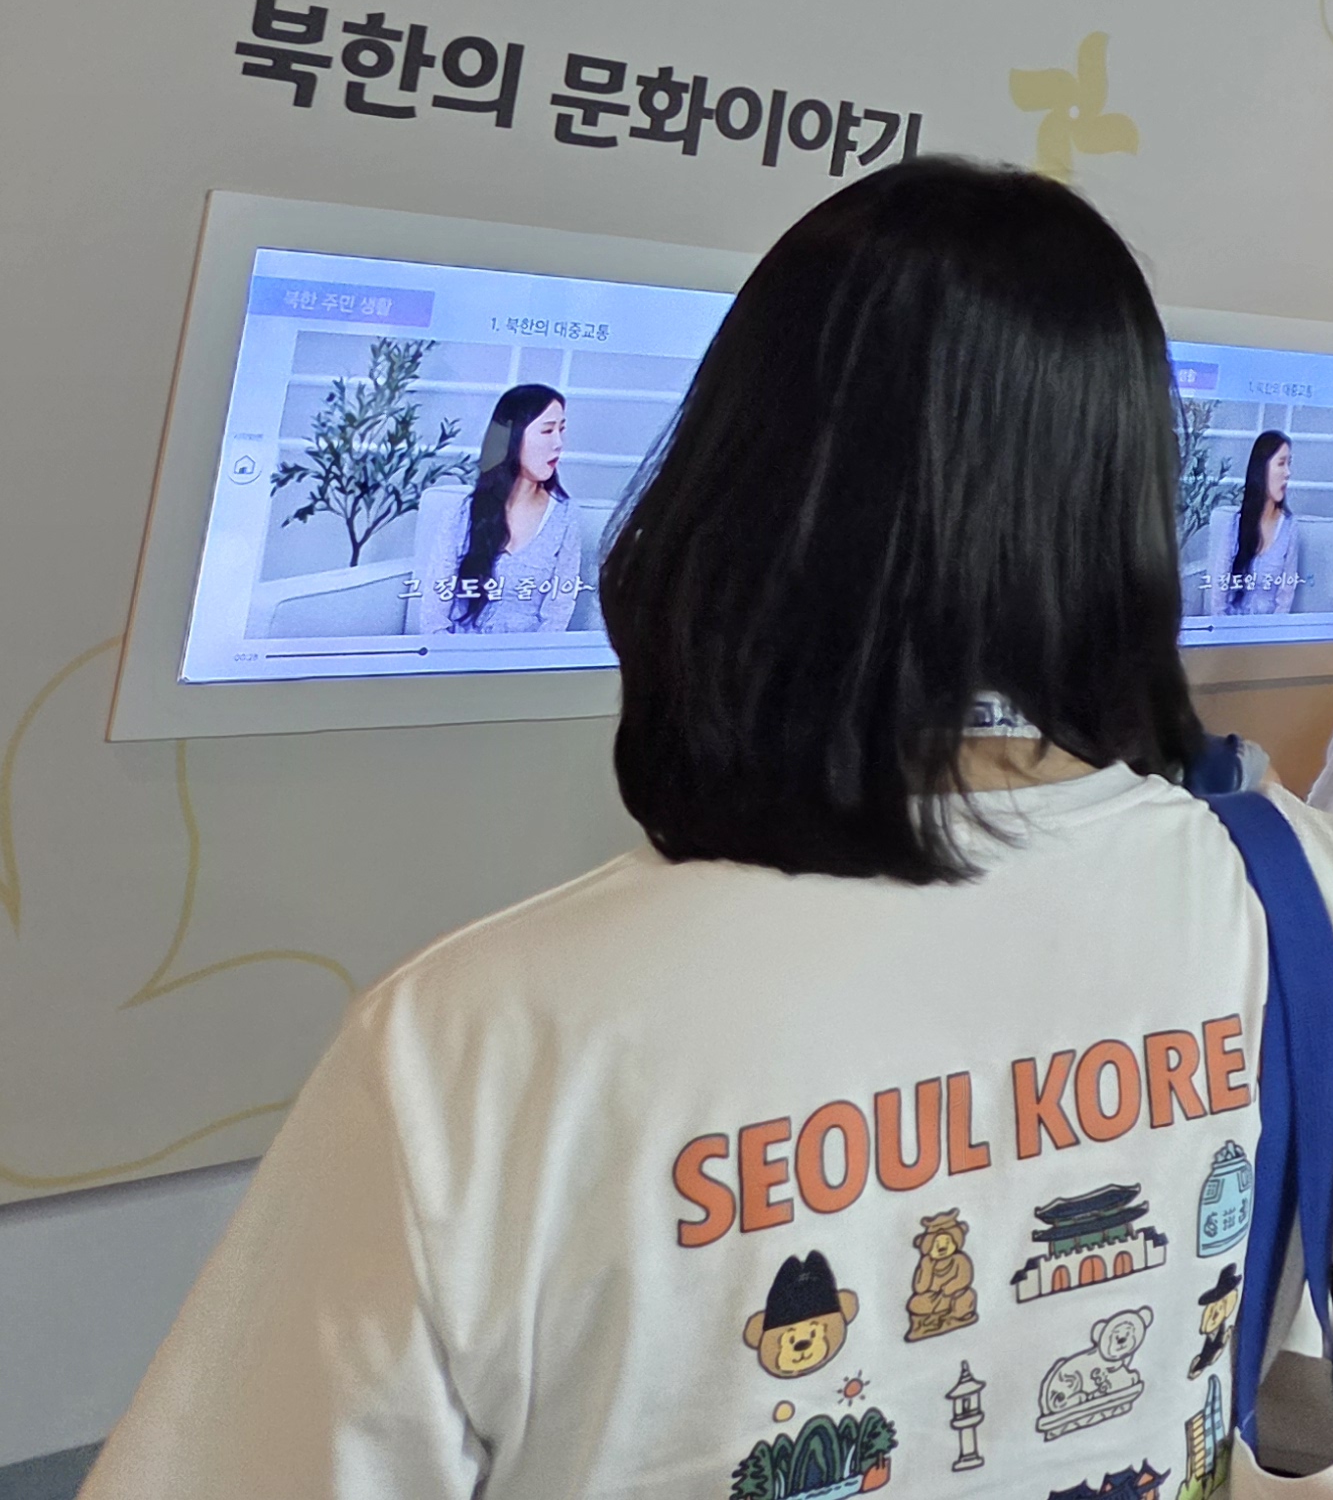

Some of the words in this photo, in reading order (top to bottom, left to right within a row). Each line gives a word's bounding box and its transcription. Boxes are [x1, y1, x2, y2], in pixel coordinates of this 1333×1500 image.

[550, 51, 923, 178] 문화이야기
[283, 289, 319, 313] 북한
[320, 293, 356, 316] 주민
[359, 295, 394, 317] 생활
[491, 317, 500, 331] 1.
[506, 316, 550, 338] 북한의
[553, 320, 611, 343] 대중교통
[397, 578, 422, 599] 그
[433, 575, 506, 601] 정도일
[1199, 573, 1212, 589] 그
[672, 1070, 992, 1248] SEOUL
[1010, 1005, 1267, 1160] KORE
